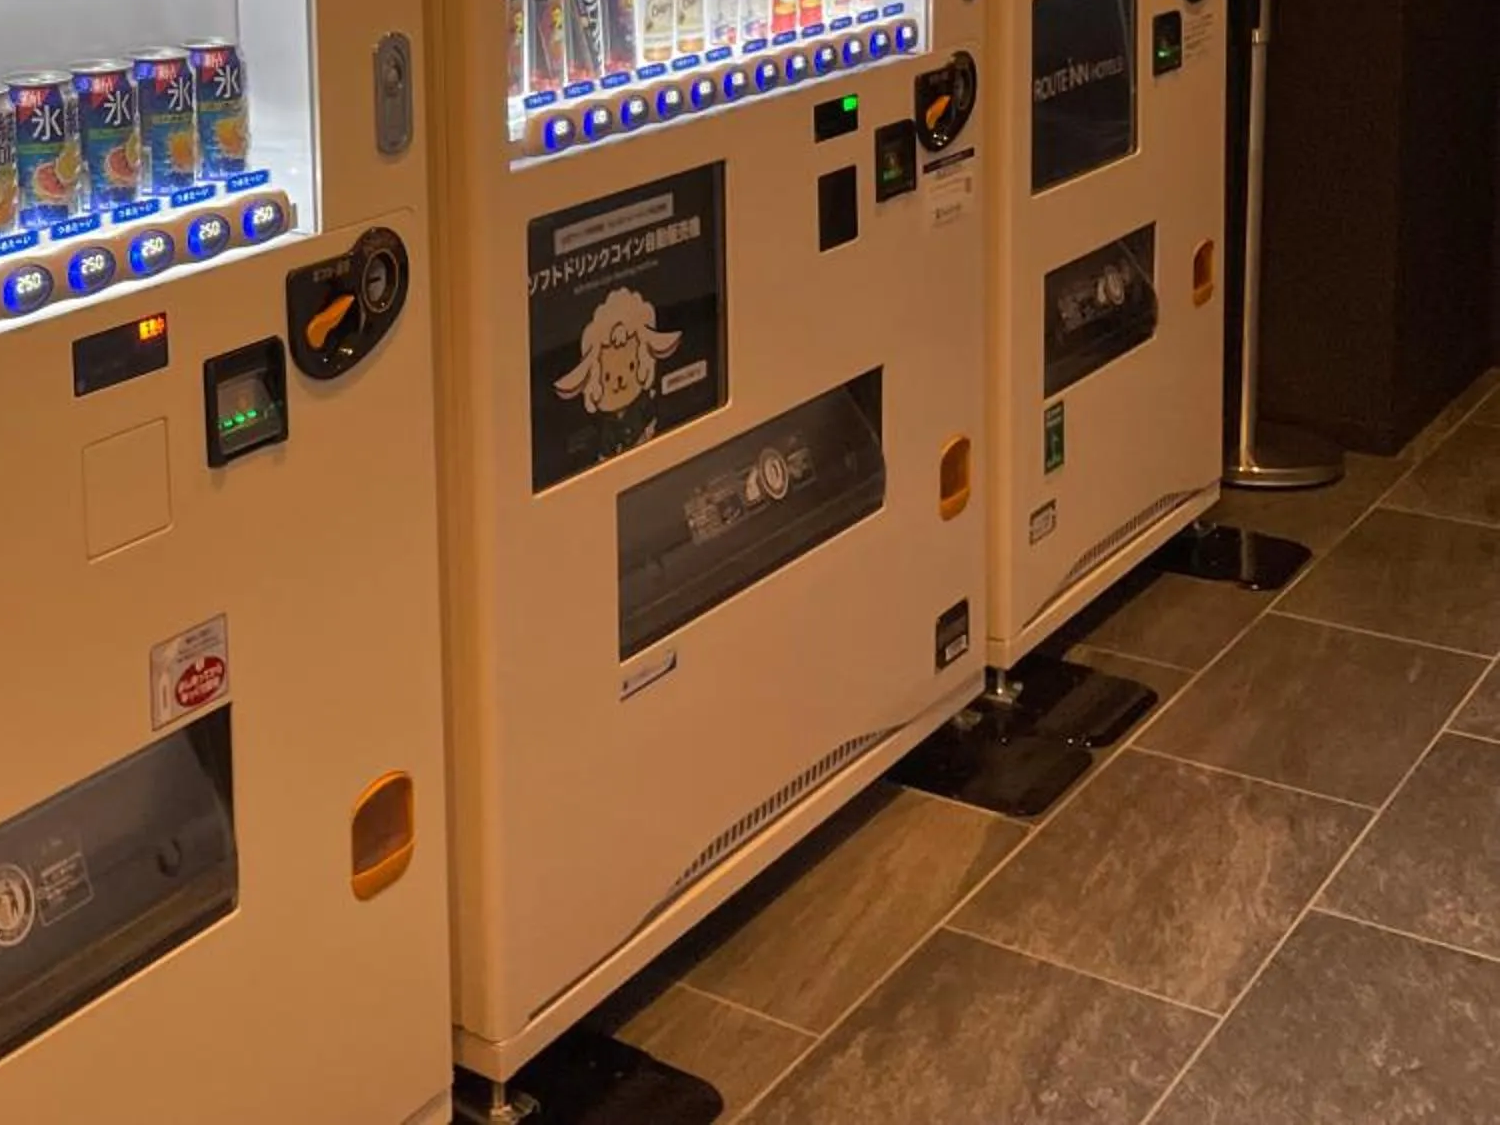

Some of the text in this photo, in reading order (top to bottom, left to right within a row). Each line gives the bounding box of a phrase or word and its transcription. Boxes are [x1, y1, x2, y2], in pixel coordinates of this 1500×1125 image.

[213, 65, 241, 99] 氷
[167, 77, 192, 112] 氷
[103, 90, 132, 125] 氷
[31, 105, 63, 141] 氷
[253, 206, 274, 224] 250
[198, 221, 221, 239] 250
[141, 237, 165, 256] 250
[80, 255, 105, 274] 250
[16, 272, 42, 292] 250
